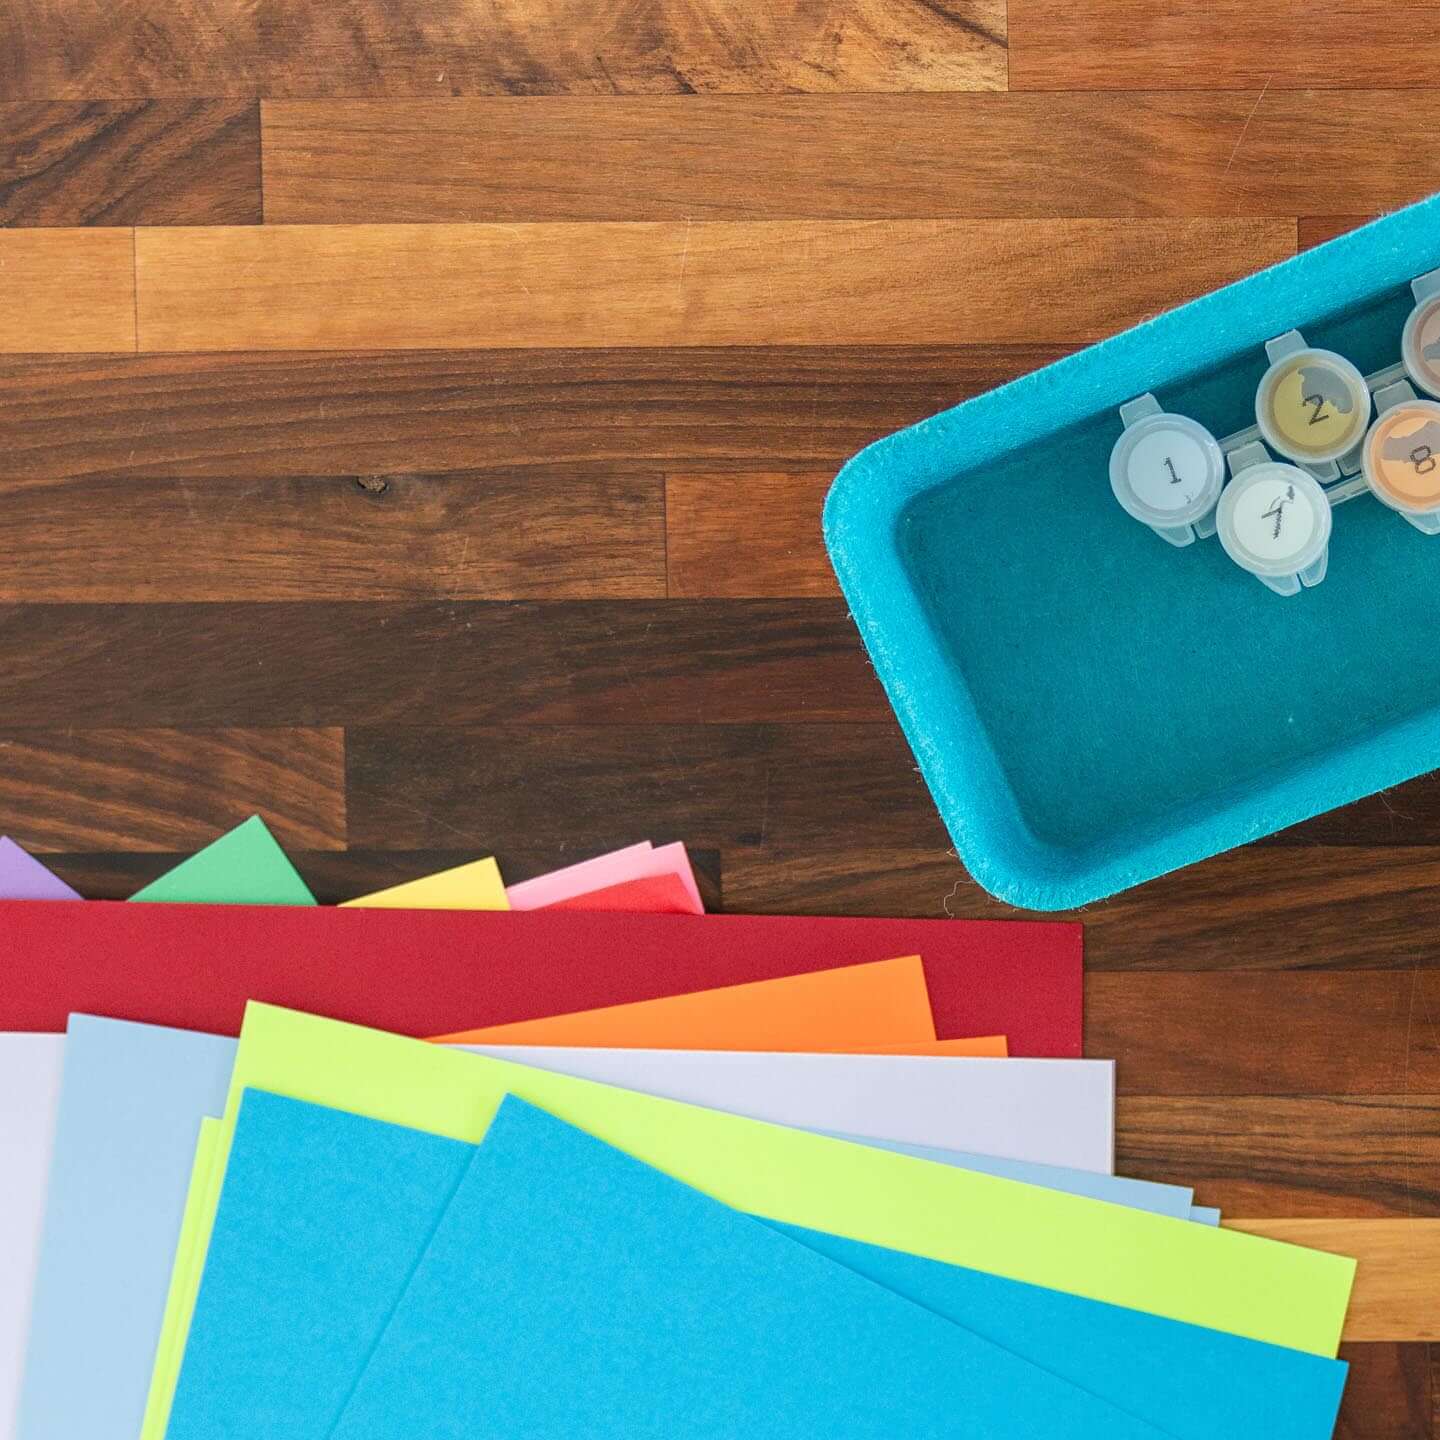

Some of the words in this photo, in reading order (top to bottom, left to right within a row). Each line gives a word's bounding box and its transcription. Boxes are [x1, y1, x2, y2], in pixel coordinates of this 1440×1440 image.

[1301, 393, 1330, 426] 2
[1163, 456, 1183, 485] 1
[1409, 445, 1436, 475] 8
[1260, 506, 1283, 540] 7
